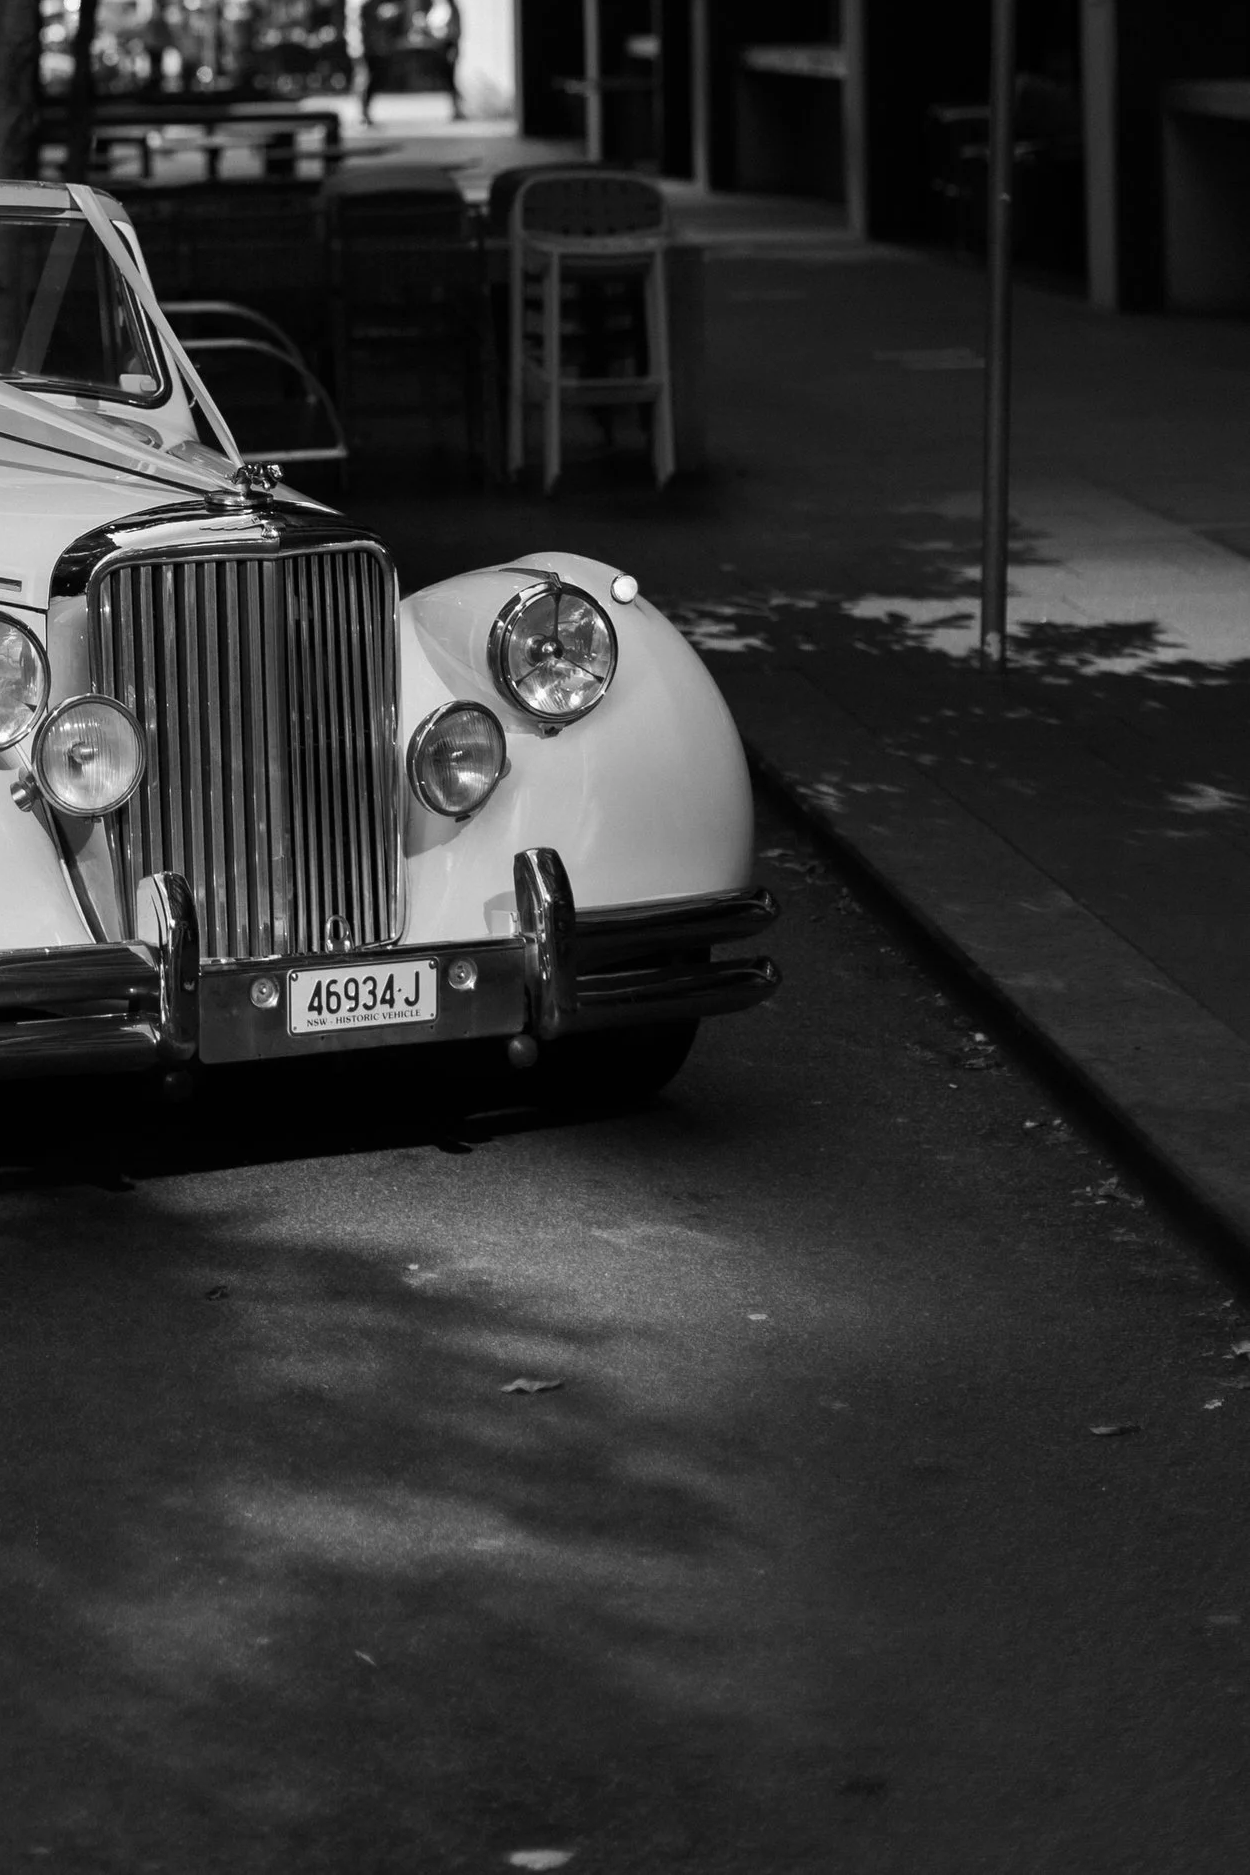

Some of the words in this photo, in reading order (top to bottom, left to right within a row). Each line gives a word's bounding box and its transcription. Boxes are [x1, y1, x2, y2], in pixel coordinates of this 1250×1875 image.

[306, 1018, 328, 1027] NSW
[335, 1013, 380, 1025] HISTORIC
[382, 1010, 421, 1020] VEHICLE
